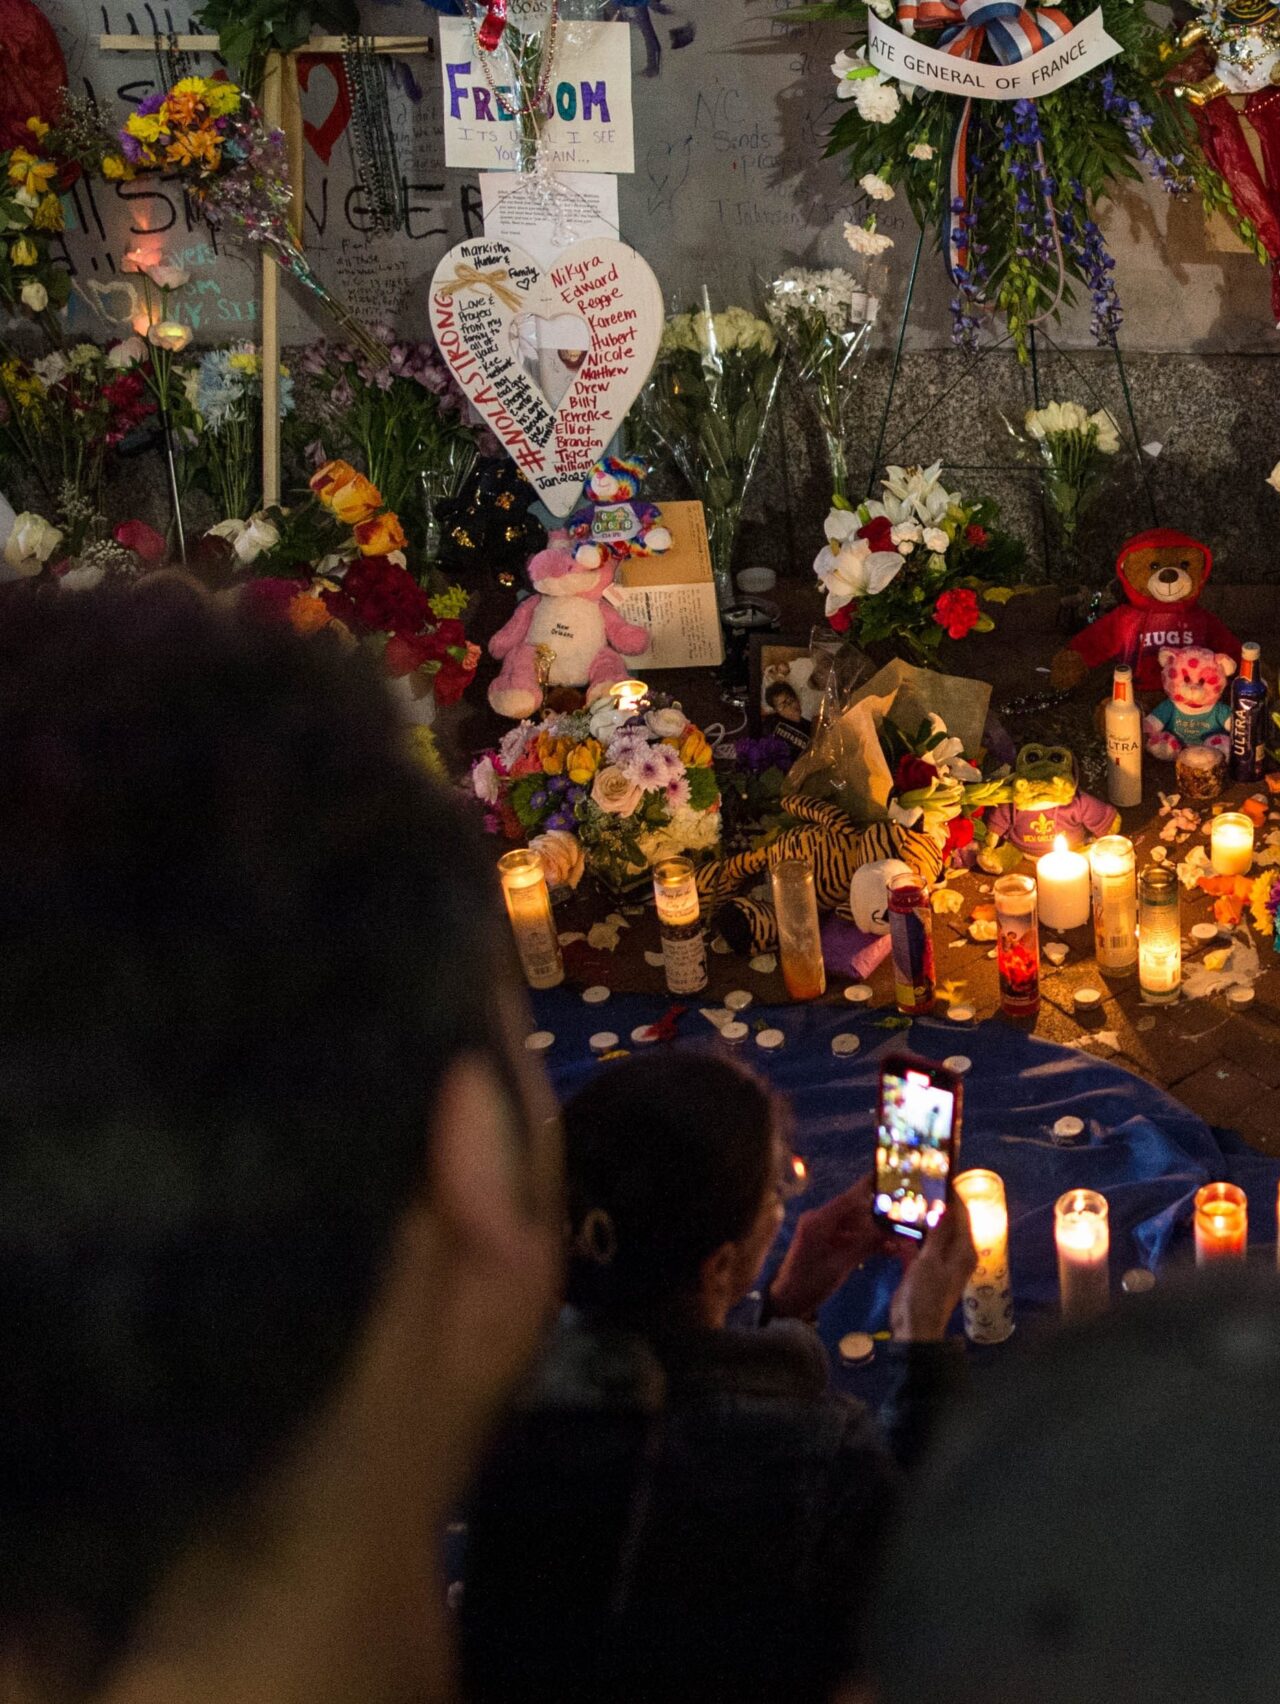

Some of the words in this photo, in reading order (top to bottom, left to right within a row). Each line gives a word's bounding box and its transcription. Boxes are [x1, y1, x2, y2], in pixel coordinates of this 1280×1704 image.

[903, 54, 985, 88] GENERAL
[995, 76, 1021, 90] OF
[1031, 40, 1087, 85] FRANCE
[445, 61, 611, 123] FREOM
[592, 130, 616, 143] SEE
[461, 242, 511, 257] Markisha
[508, 266, 540, 283] Family
[560, 263, 619, 304] Edward
[459, 297, 486, 311] Love
[577, 286, 623, 314] Reggie
[461, 323, 486, 335] from
[487, 318, 502, 328] my
[588, 308, 637, 331] Kareem
[470, 342, 483, 351] all
[484, 338, 495, 347] of
[591, 328, 637, 351] Hubert
[588, 348, 635, 366] Nicole
[580, 366, 629, 380] Matthew
[574, 381, 609, 395] Drew
[569, 395, 597, 410] Billy
[559, 408, 612, 422] Terrence
[555, 436, 603, 448] Brandon
[555, 449, 591, 463] Tiger
[536, 476, 561, 490] Jan
[560, 472, 587, 483] 2025
[1140, 631, 1194, 647] HUGS
[1234, 709, 1249, 756] ULTRA
[1108, 739, 1139, 752] LTRA
